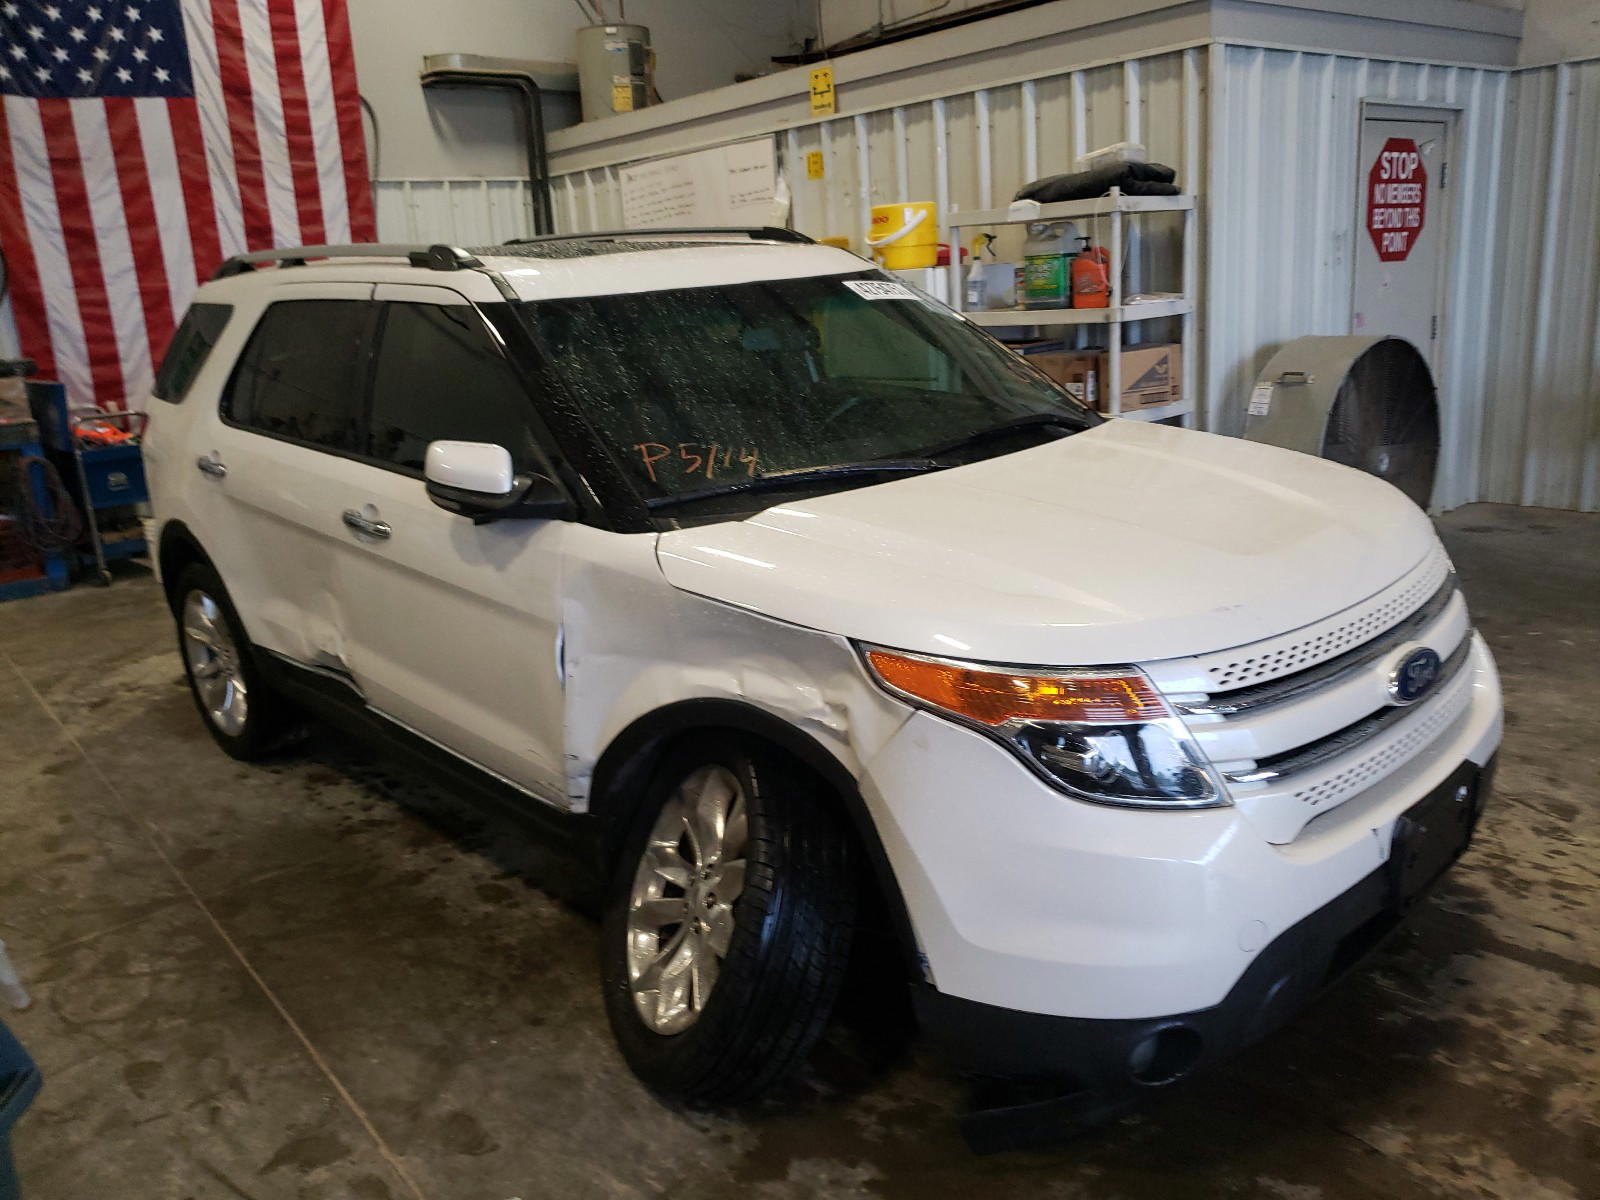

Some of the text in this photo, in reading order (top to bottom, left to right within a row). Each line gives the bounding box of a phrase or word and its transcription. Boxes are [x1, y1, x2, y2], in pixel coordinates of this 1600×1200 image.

[1380, 151, 1419, 180] STOP
[1374, 183, 1388, 204] NO
[1372, 207, 1420, 229] BEYOND THIS
[1381, 231, 1409, 253] POINT
[633, 442, 671, 482] P
